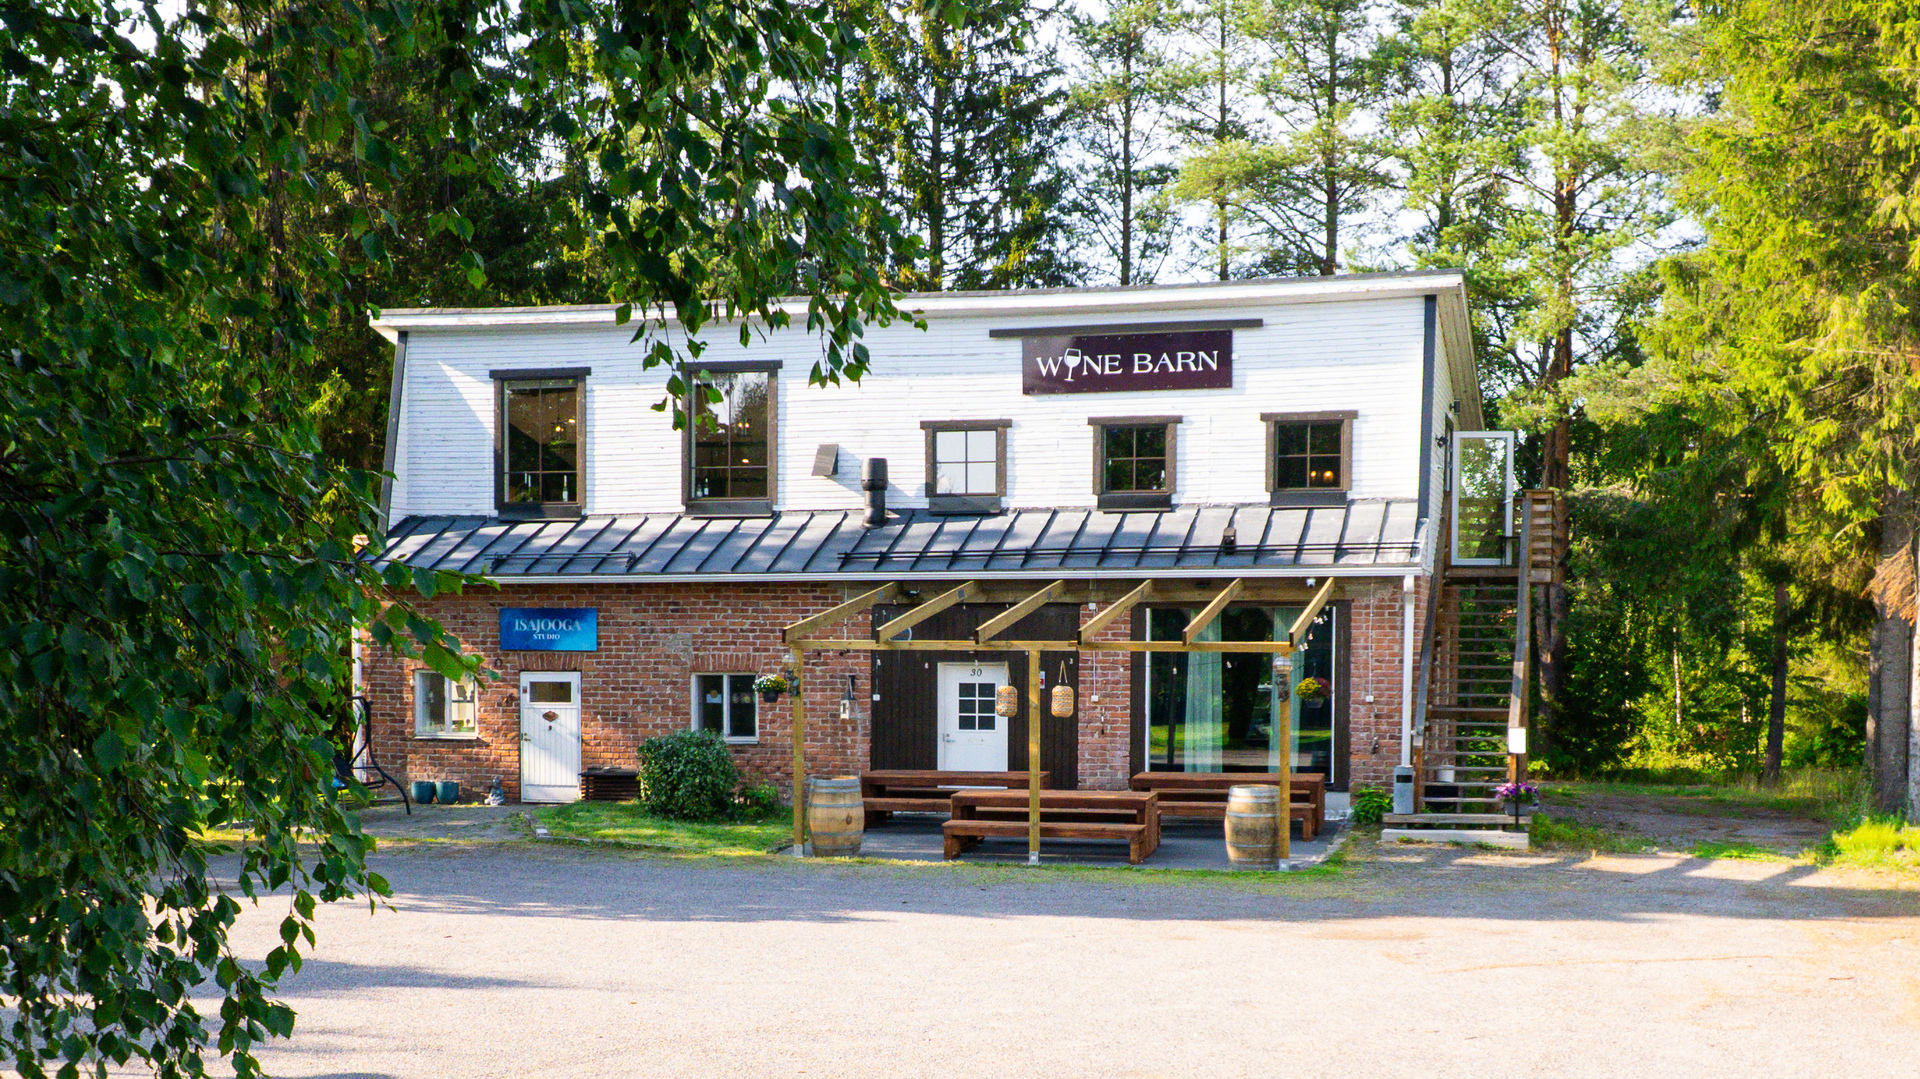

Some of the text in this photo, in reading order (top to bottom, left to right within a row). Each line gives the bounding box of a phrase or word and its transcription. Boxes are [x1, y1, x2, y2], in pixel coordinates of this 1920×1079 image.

[1132, 351, 1219, 374] BARN
[514, 618, 581, 633] ISAJOOGA
[970, 668, 982, 677] 30
